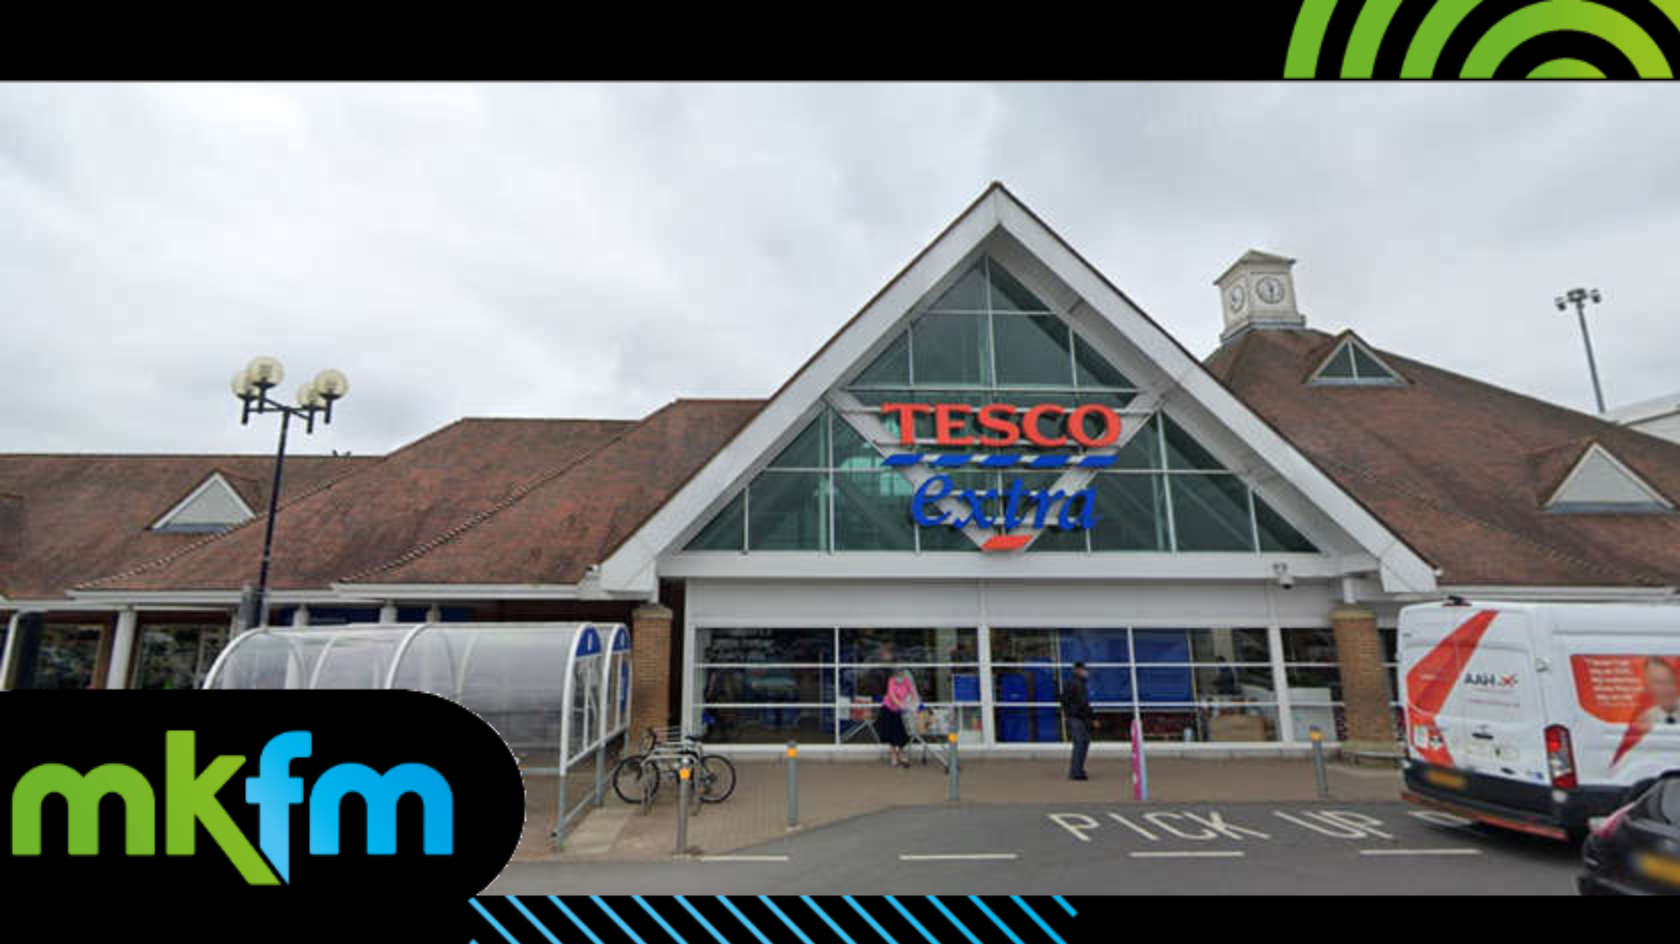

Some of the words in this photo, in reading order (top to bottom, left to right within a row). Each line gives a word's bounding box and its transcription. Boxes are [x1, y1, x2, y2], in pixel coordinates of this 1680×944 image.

[881, 402, 1122, 448] TESCO
[911, 474, 1102, 529] extra
[1048, 811, 1271, 841] PICK
[1273, 810, 1394, 839] UP
